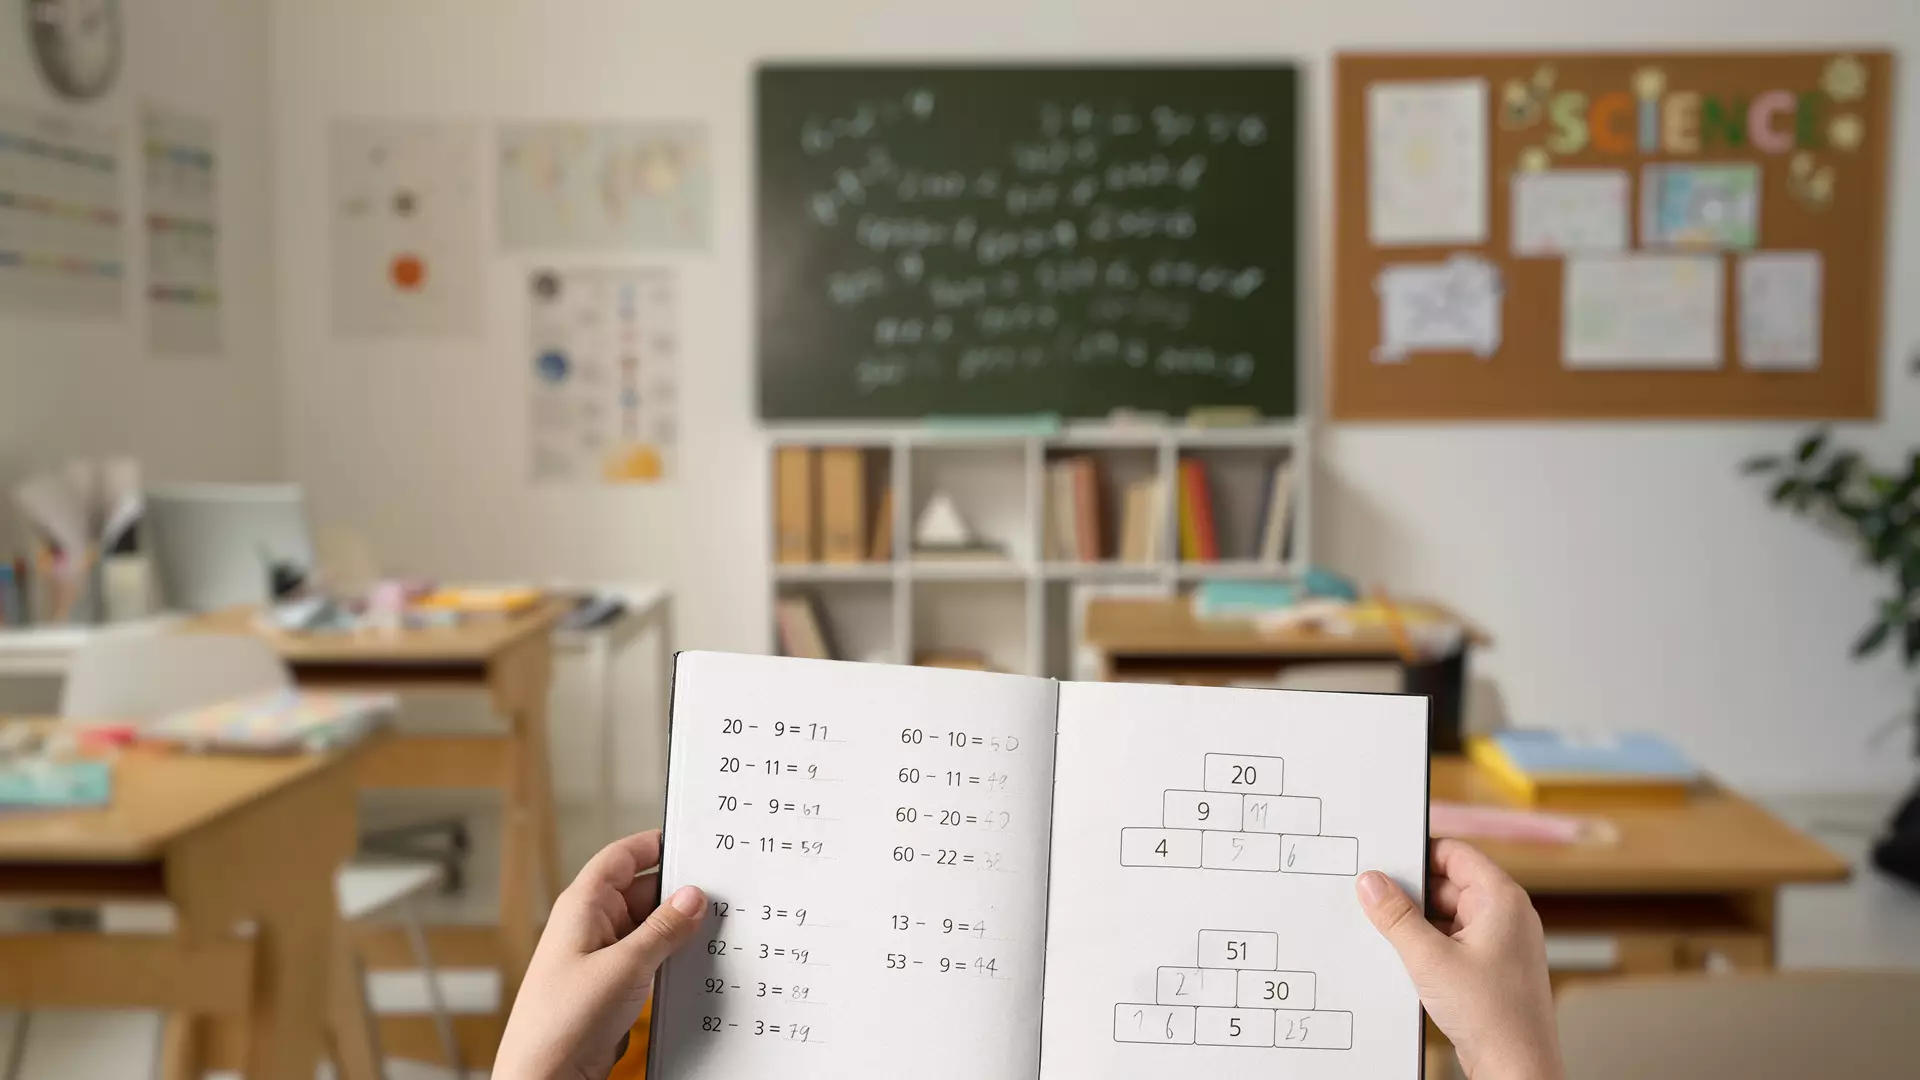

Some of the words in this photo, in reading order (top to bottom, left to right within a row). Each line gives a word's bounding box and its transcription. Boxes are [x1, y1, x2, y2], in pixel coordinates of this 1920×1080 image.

[1547, 91, 1822, 154] SCIENCE
[723, 718, 743, 735] 20
[774, 721, 785, 737] 9
[789, 725, 801, 734] =
[901, 728, 923, 745] 60
[948, 731, 967, 748] 10
[971, 736, 983, 745] =
[719, 756, 740, 773] 20
[765, 759, 780, 776] 11
[786, 764, 798, 773] =
[807, 764, 818, 780] 9
[898, 767, 920, 784] 60
[946, 770, 961, 787] 11
[968, 776, 981, 784] =
[1230, 764, 1257, 786] 20
[717, 795, 738, 812] 70
[768, 798, 780, 815] 9
[783, 803, 796, 811] =
[1197, 801, 1210, 822] 9
[895, 806, 918, 824] 60
[939, 809, 961, 827] 20
[965, 815, 978, 823] =
[715, 833, 735, 851] 70
[759, 836, 774, 853] 11
[781, 842, 793, 850] =
[800, 840, 823, 855] 59
[1154, 838, 1169, 858] 4
[1231, 837, 1245, 863] 5
[893, 845, 915, 863] 60
[936, 848, 958, 866] 22
[962, 854, 975, 863] =
[1286, 843, 1297, 868] 6
[712, 901, 730, 918] 12
[761, 904, 772, 921] 3
[776, 909, 788, 918] =
[795, 908, 807, 927] 9
[891, 914, 910, 931] 13
[942, 918, 953, 934] 9
[957, 923, 970, 931] =
[972, 919, 987, 938] 4
[707, 939, 727, 956] 62
[758, 943, 769, 959] 3
[773, 948, 786, 956] =
[791, 948, 810, 965] 59
[1226, 940, 1248, 961] 51
[886, 953, 907, 970] 53
[939, 957, 951, 973] 9
[954, 962, 967, 970] =
[973, 956, 999, 977] 44
[704, 977, 725, 995] 92
[756, 981, 767, 998] 3
[771, 986, 783, 995] =
[791, 985, 810, 1000] 89
[1262, 980, 1290, 1001] 30
[701, 1015, 722, 1033] 82
[753, 1019, 765, 1036] 3
[769, 1025, 781, 1033] =
[788, 1023, 811, 1043] 79
[1229, 1017, 1242, 1037] 5
[1284, 1016, 1312, 1042] 25
